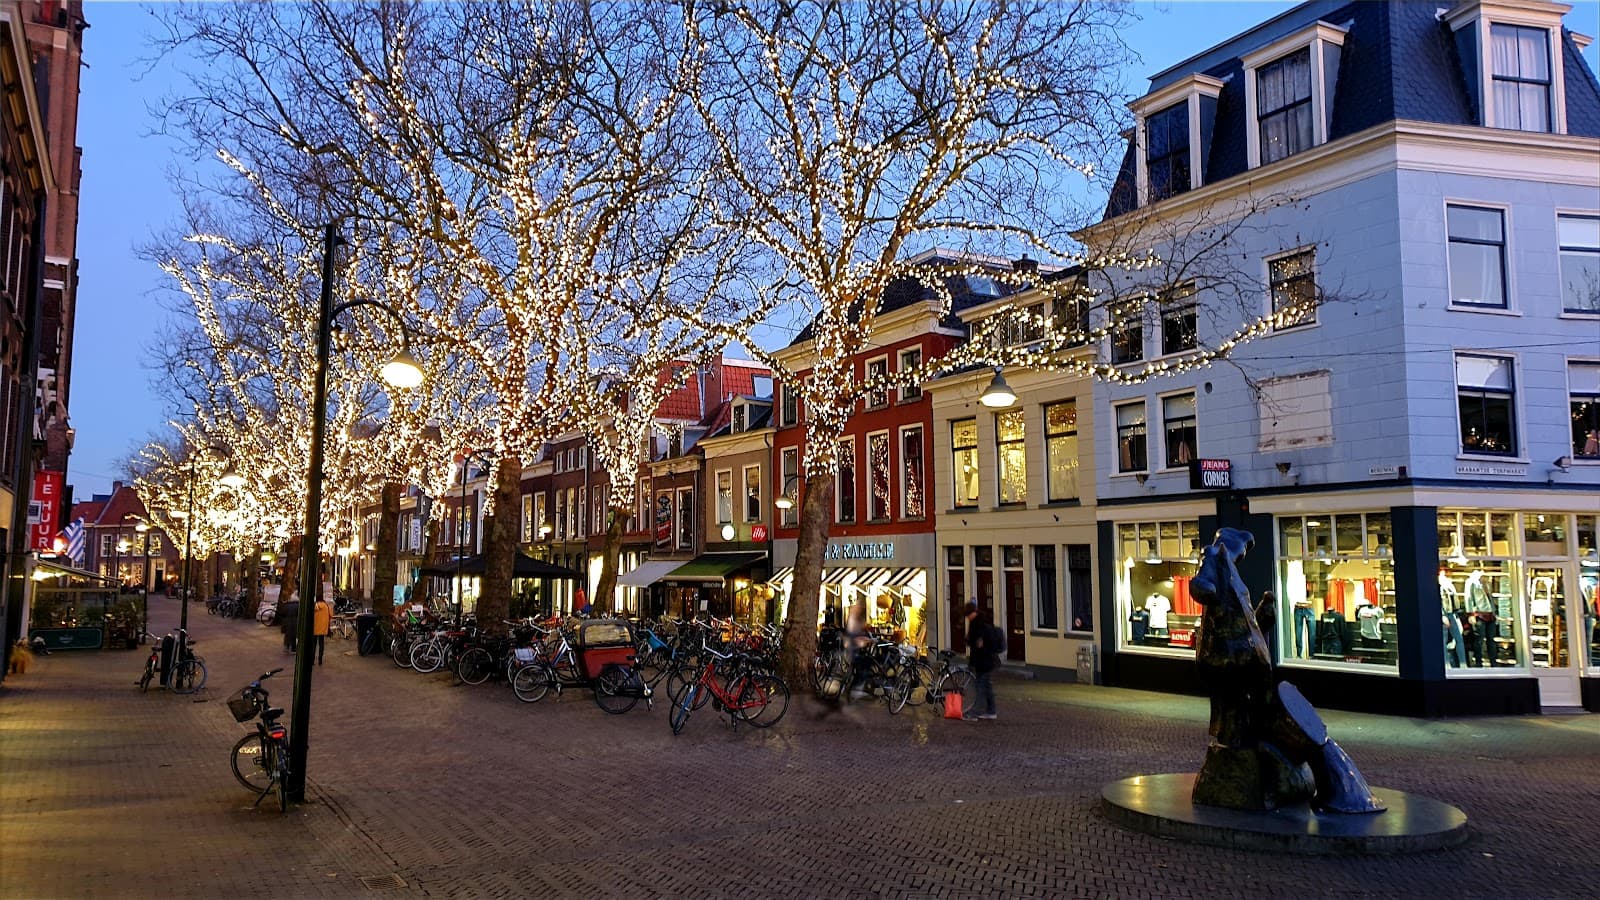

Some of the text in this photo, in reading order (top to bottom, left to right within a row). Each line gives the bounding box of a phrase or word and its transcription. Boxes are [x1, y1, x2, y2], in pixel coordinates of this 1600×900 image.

[1202, 460, 1230, 469] JEANS
[1203, 470, 1230, 487] CORNER
[38, 500, 52, 547] HUUR
[842, 542, 894, 560] KAMILLE
